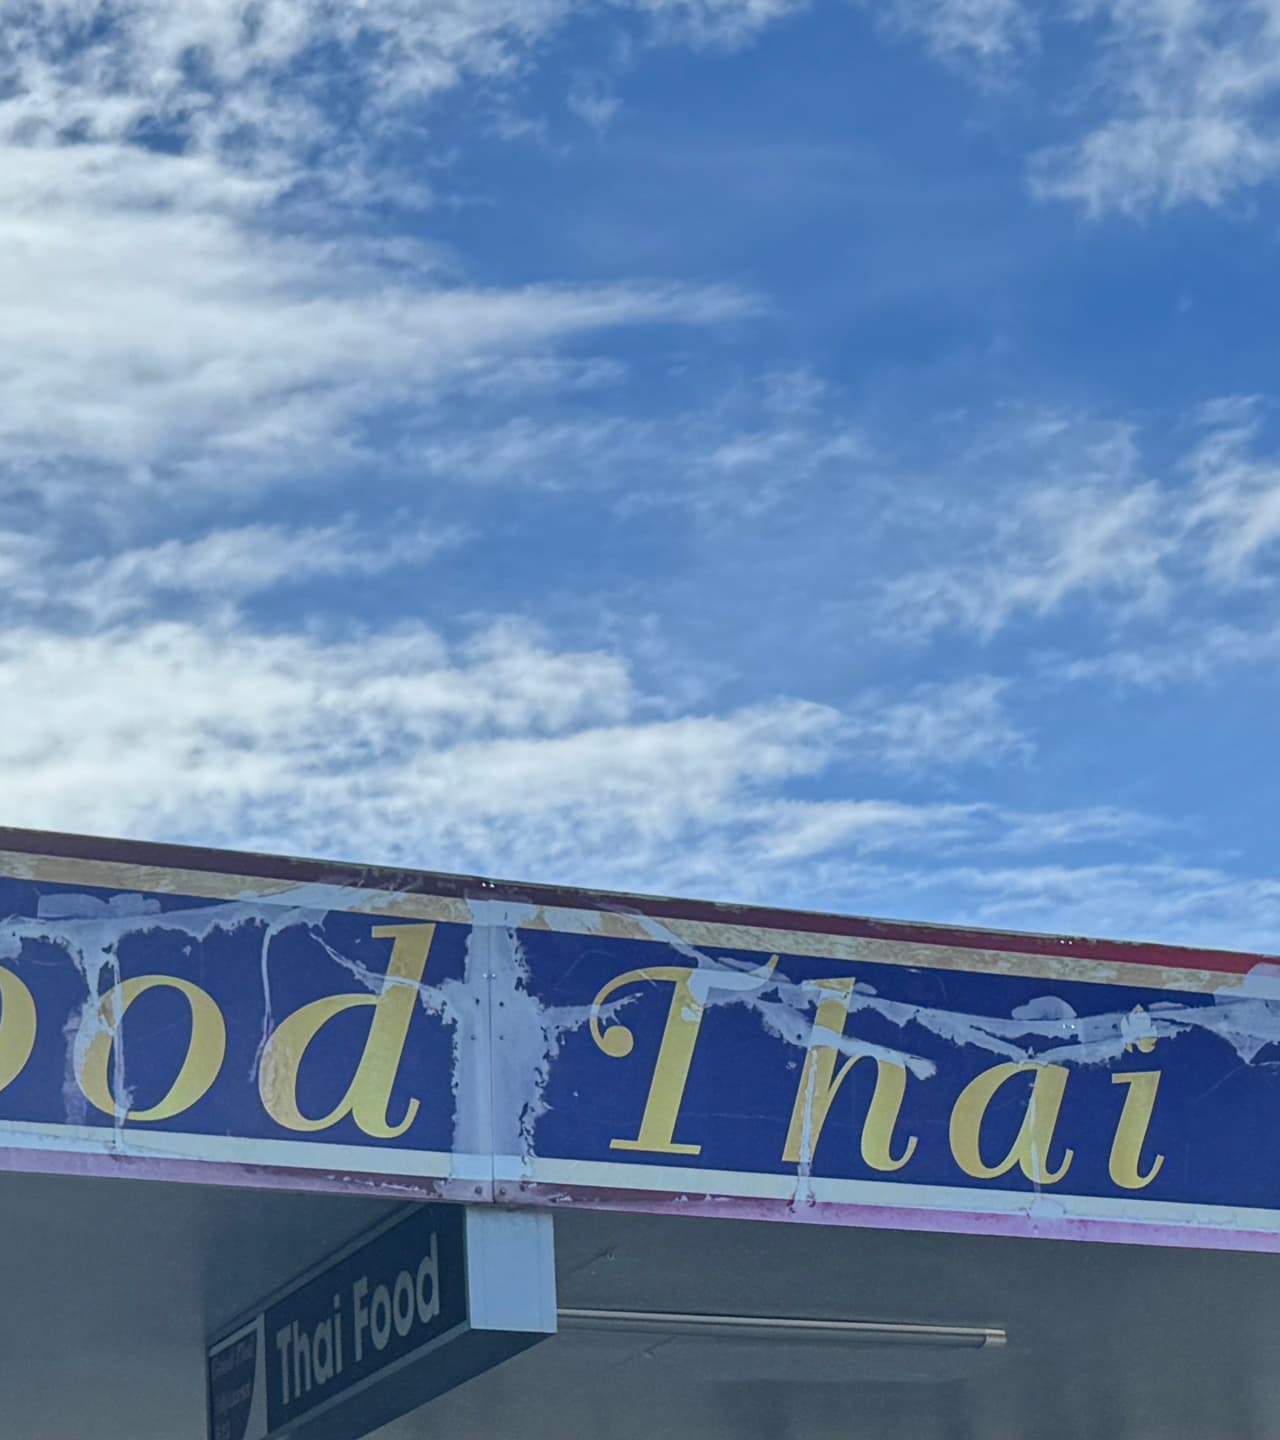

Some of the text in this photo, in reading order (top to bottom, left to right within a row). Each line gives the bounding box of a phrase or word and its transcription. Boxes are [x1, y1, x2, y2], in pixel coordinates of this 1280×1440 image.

[590, 954, 1165, 1189] Thai
[276, 1293, 343, 1406] Thai
[353, 1232, 440, 1363] Food
